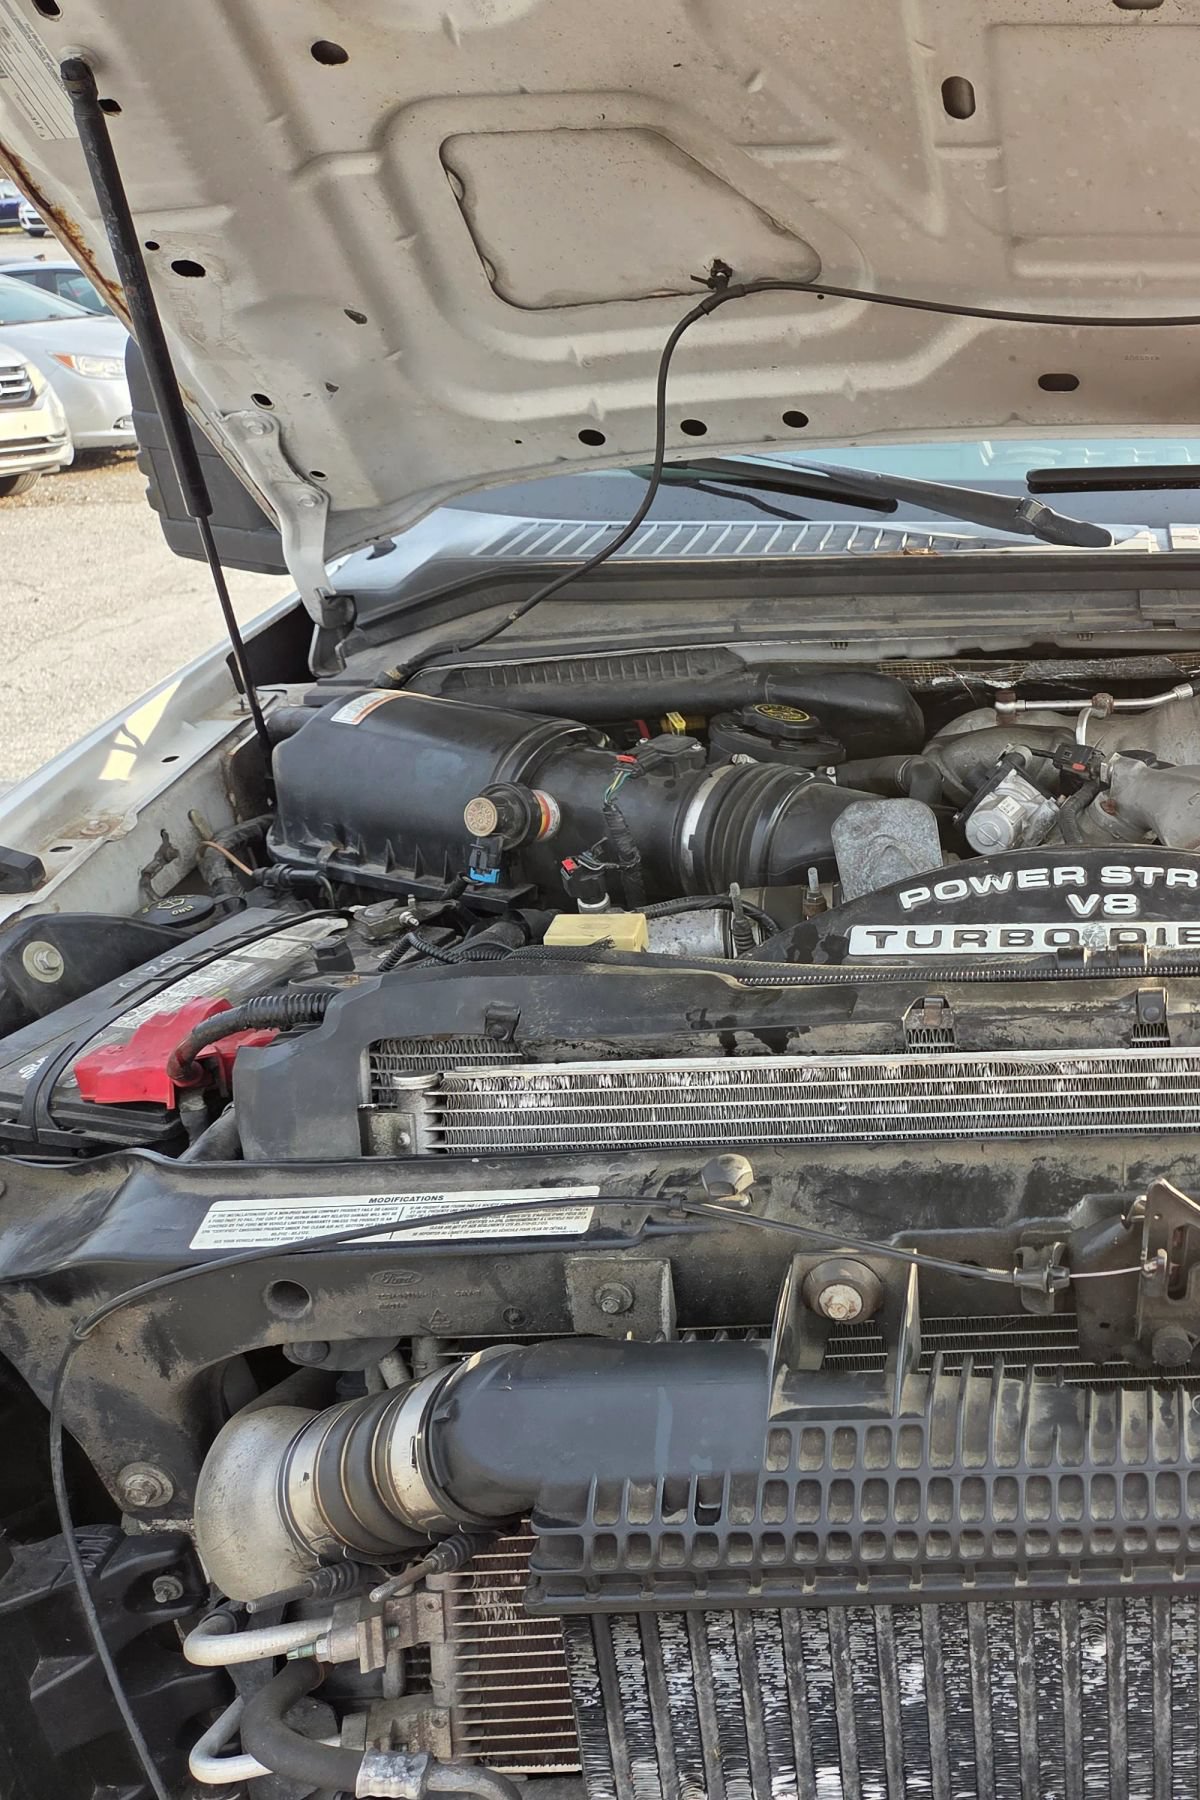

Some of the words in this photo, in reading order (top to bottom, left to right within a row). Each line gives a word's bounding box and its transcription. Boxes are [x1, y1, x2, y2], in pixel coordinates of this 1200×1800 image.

[899, 865, 1085, 910] POWER
[1066, 892, 1138, 917] V8
[865, 928, 1088, 951] TURBO
[368, 1195, 444, 1203] MODIFICATIONS
[381, 1272, 415, 1284] Ford
